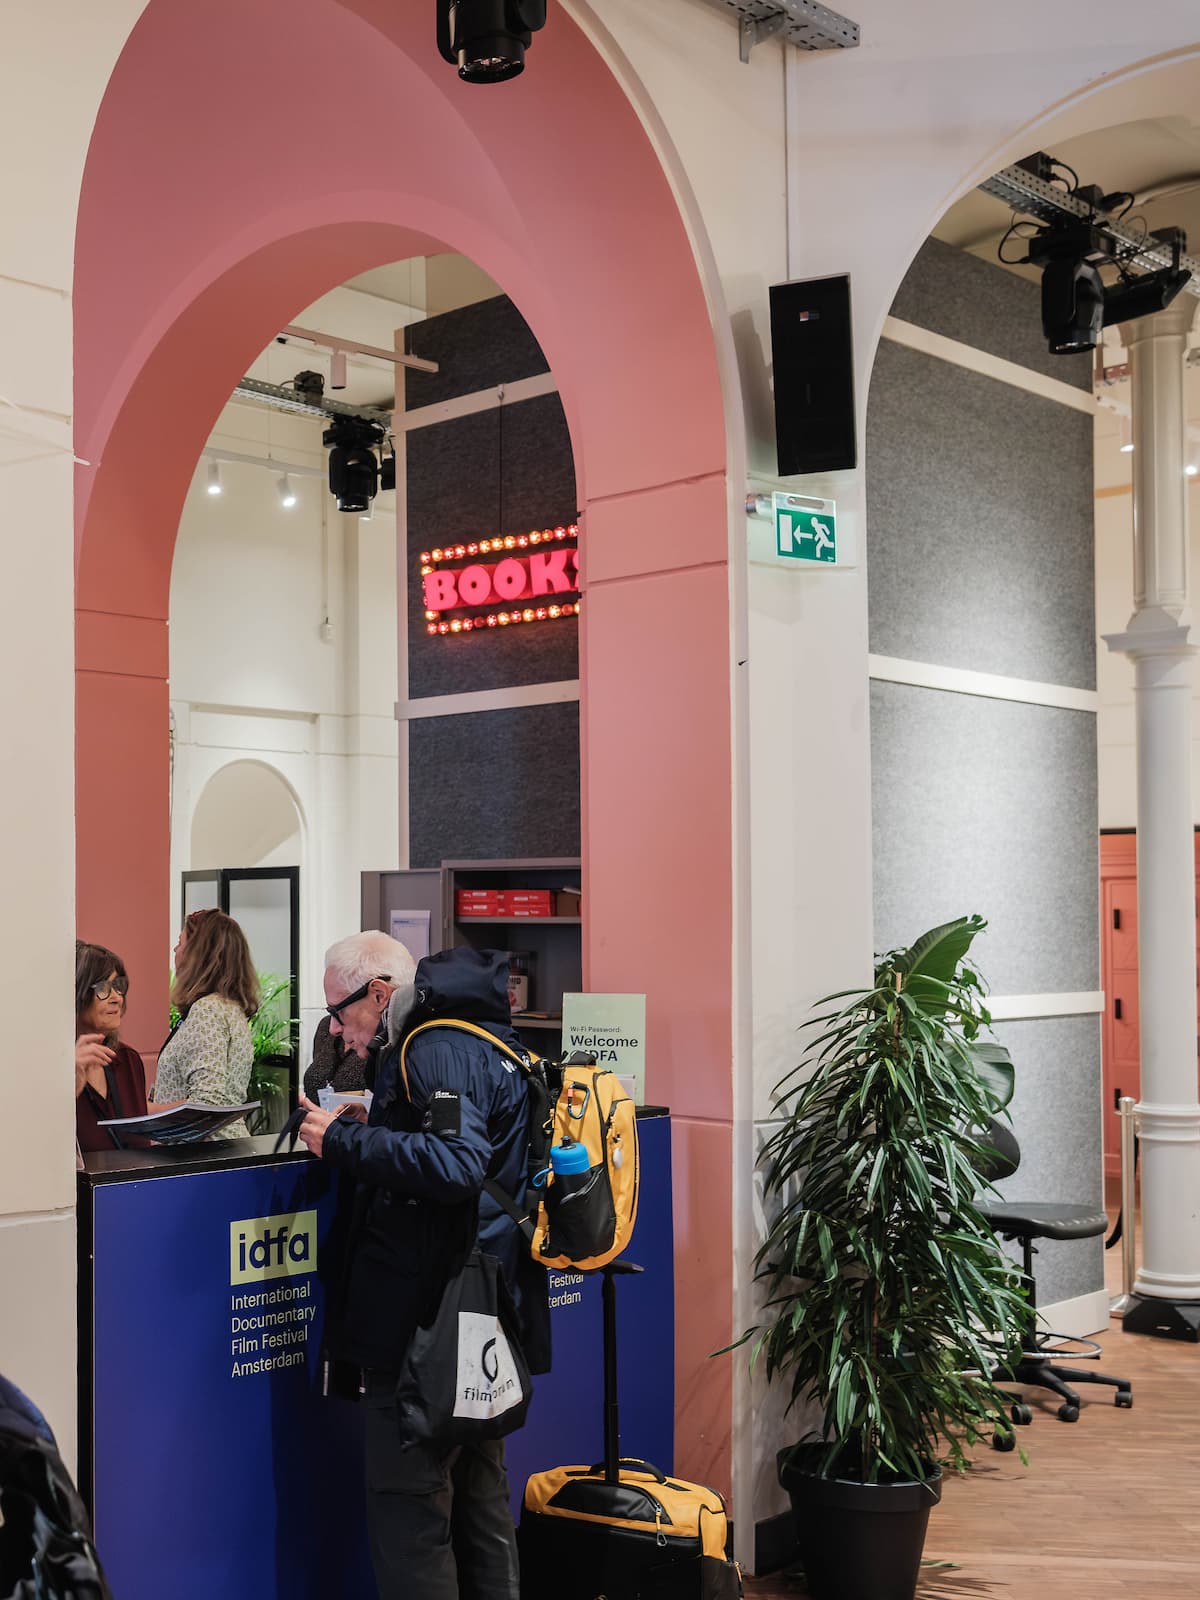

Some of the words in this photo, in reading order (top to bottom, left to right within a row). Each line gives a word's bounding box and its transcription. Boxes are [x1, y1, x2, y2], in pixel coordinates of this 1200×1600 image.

[424, 549, 579, 611] BOOK
[570, 1035, 638, 1047] Welcome
[585, 1050, 618, 1061] DFA
[239, 1226, 310, 1272] idfa
[231, 1281, 311, 1310] International
[548, 1291, 582, 1308] terdam
[231, 1305, 317, 1333] Documentary
[231, 1337, 258, 1356] Film
[262, 1325, 308, 1349] Festival
[231, 1351, 305, 1378] Amsterdam
